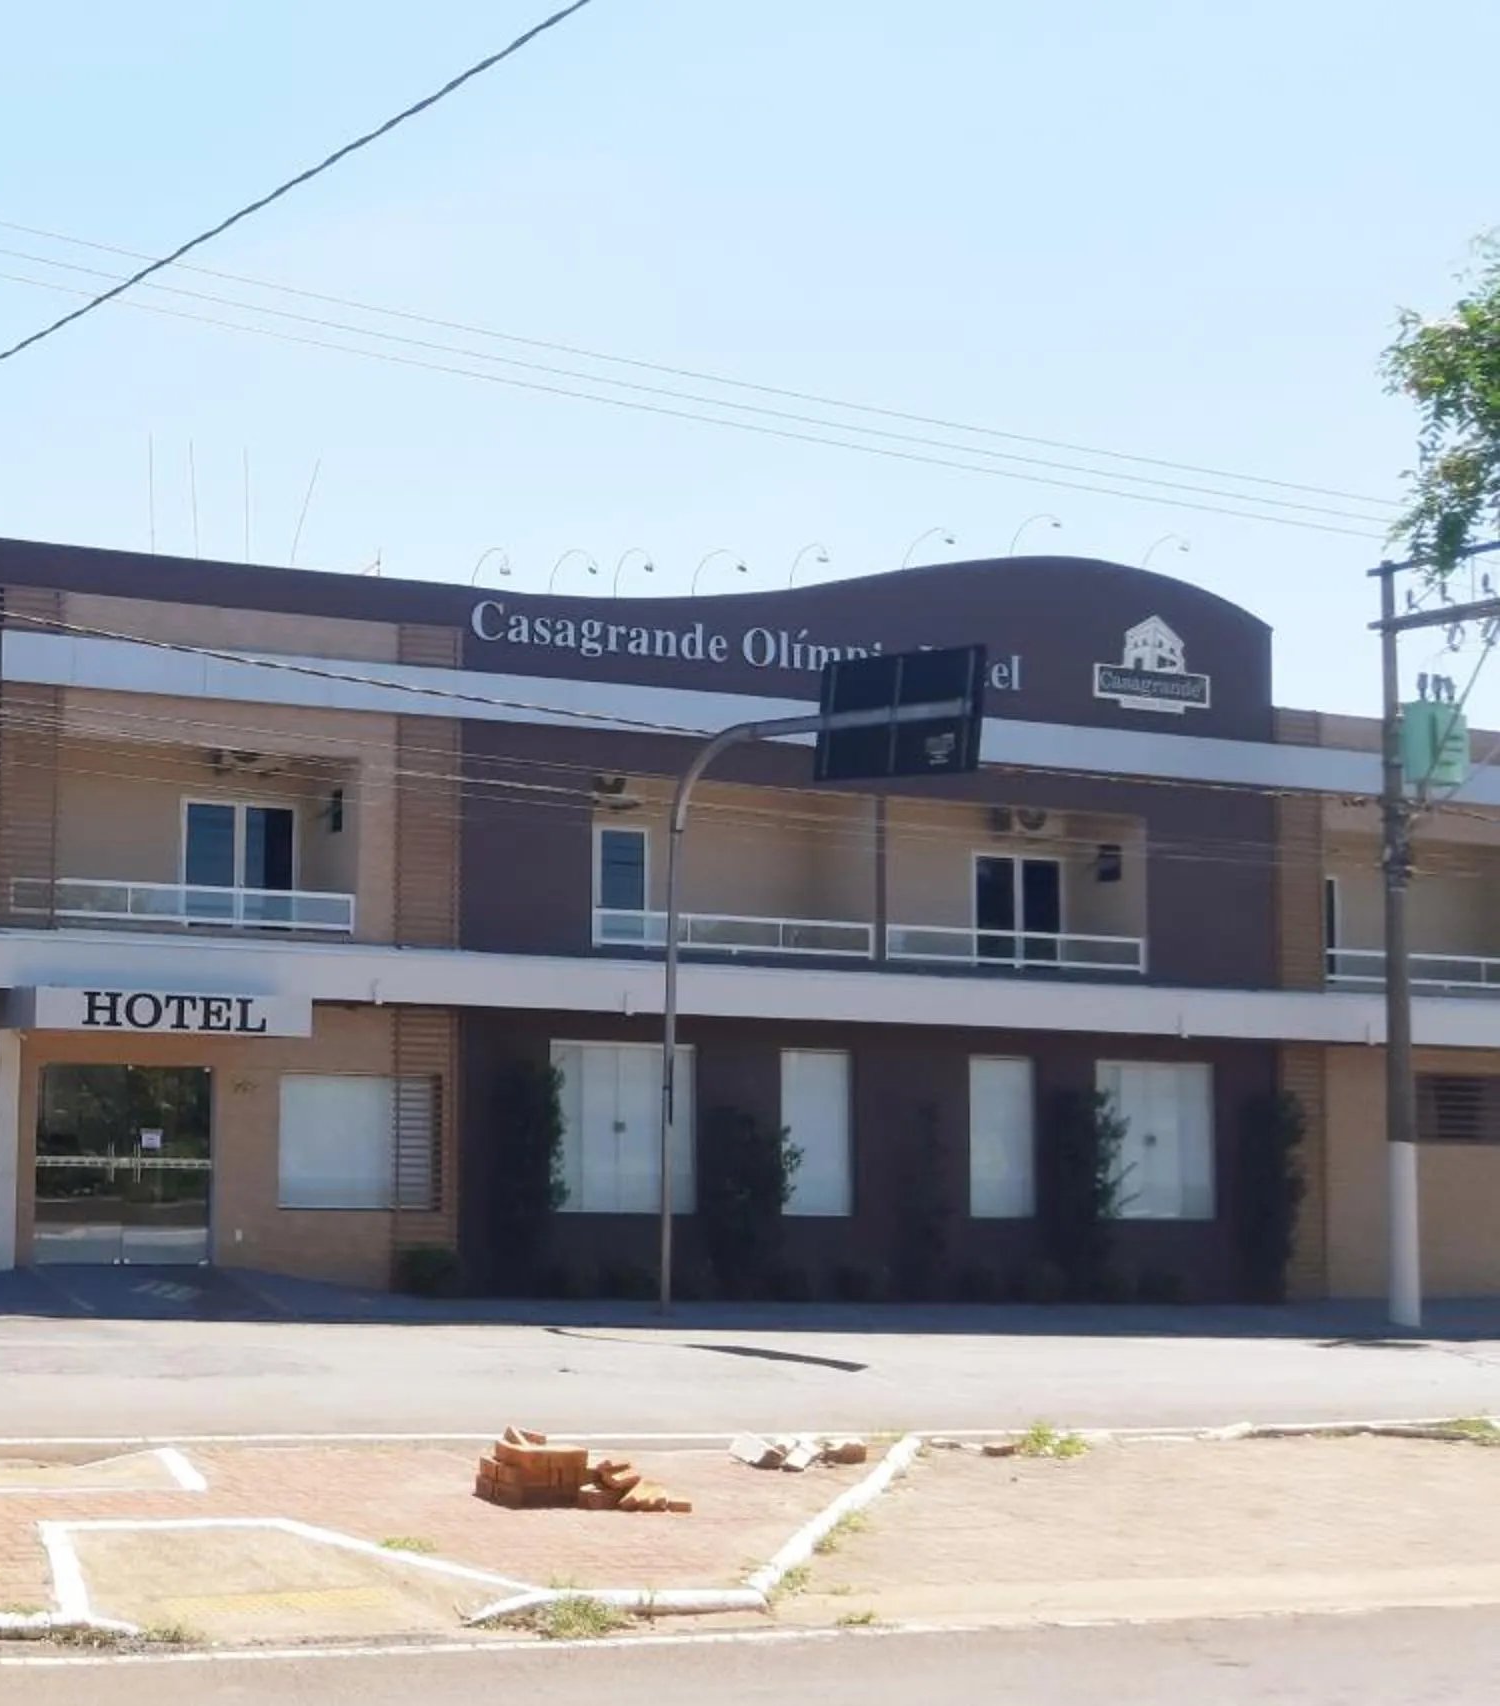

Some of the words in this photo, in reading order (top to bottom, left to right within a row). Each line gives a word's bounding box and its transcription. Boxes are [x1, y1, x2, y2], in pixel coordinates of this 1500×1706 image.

[471, 600, 729, 662] Casagrande
[742, 626, 884, 672] Olím
[82, 991, 267, 1033] HOTEL
